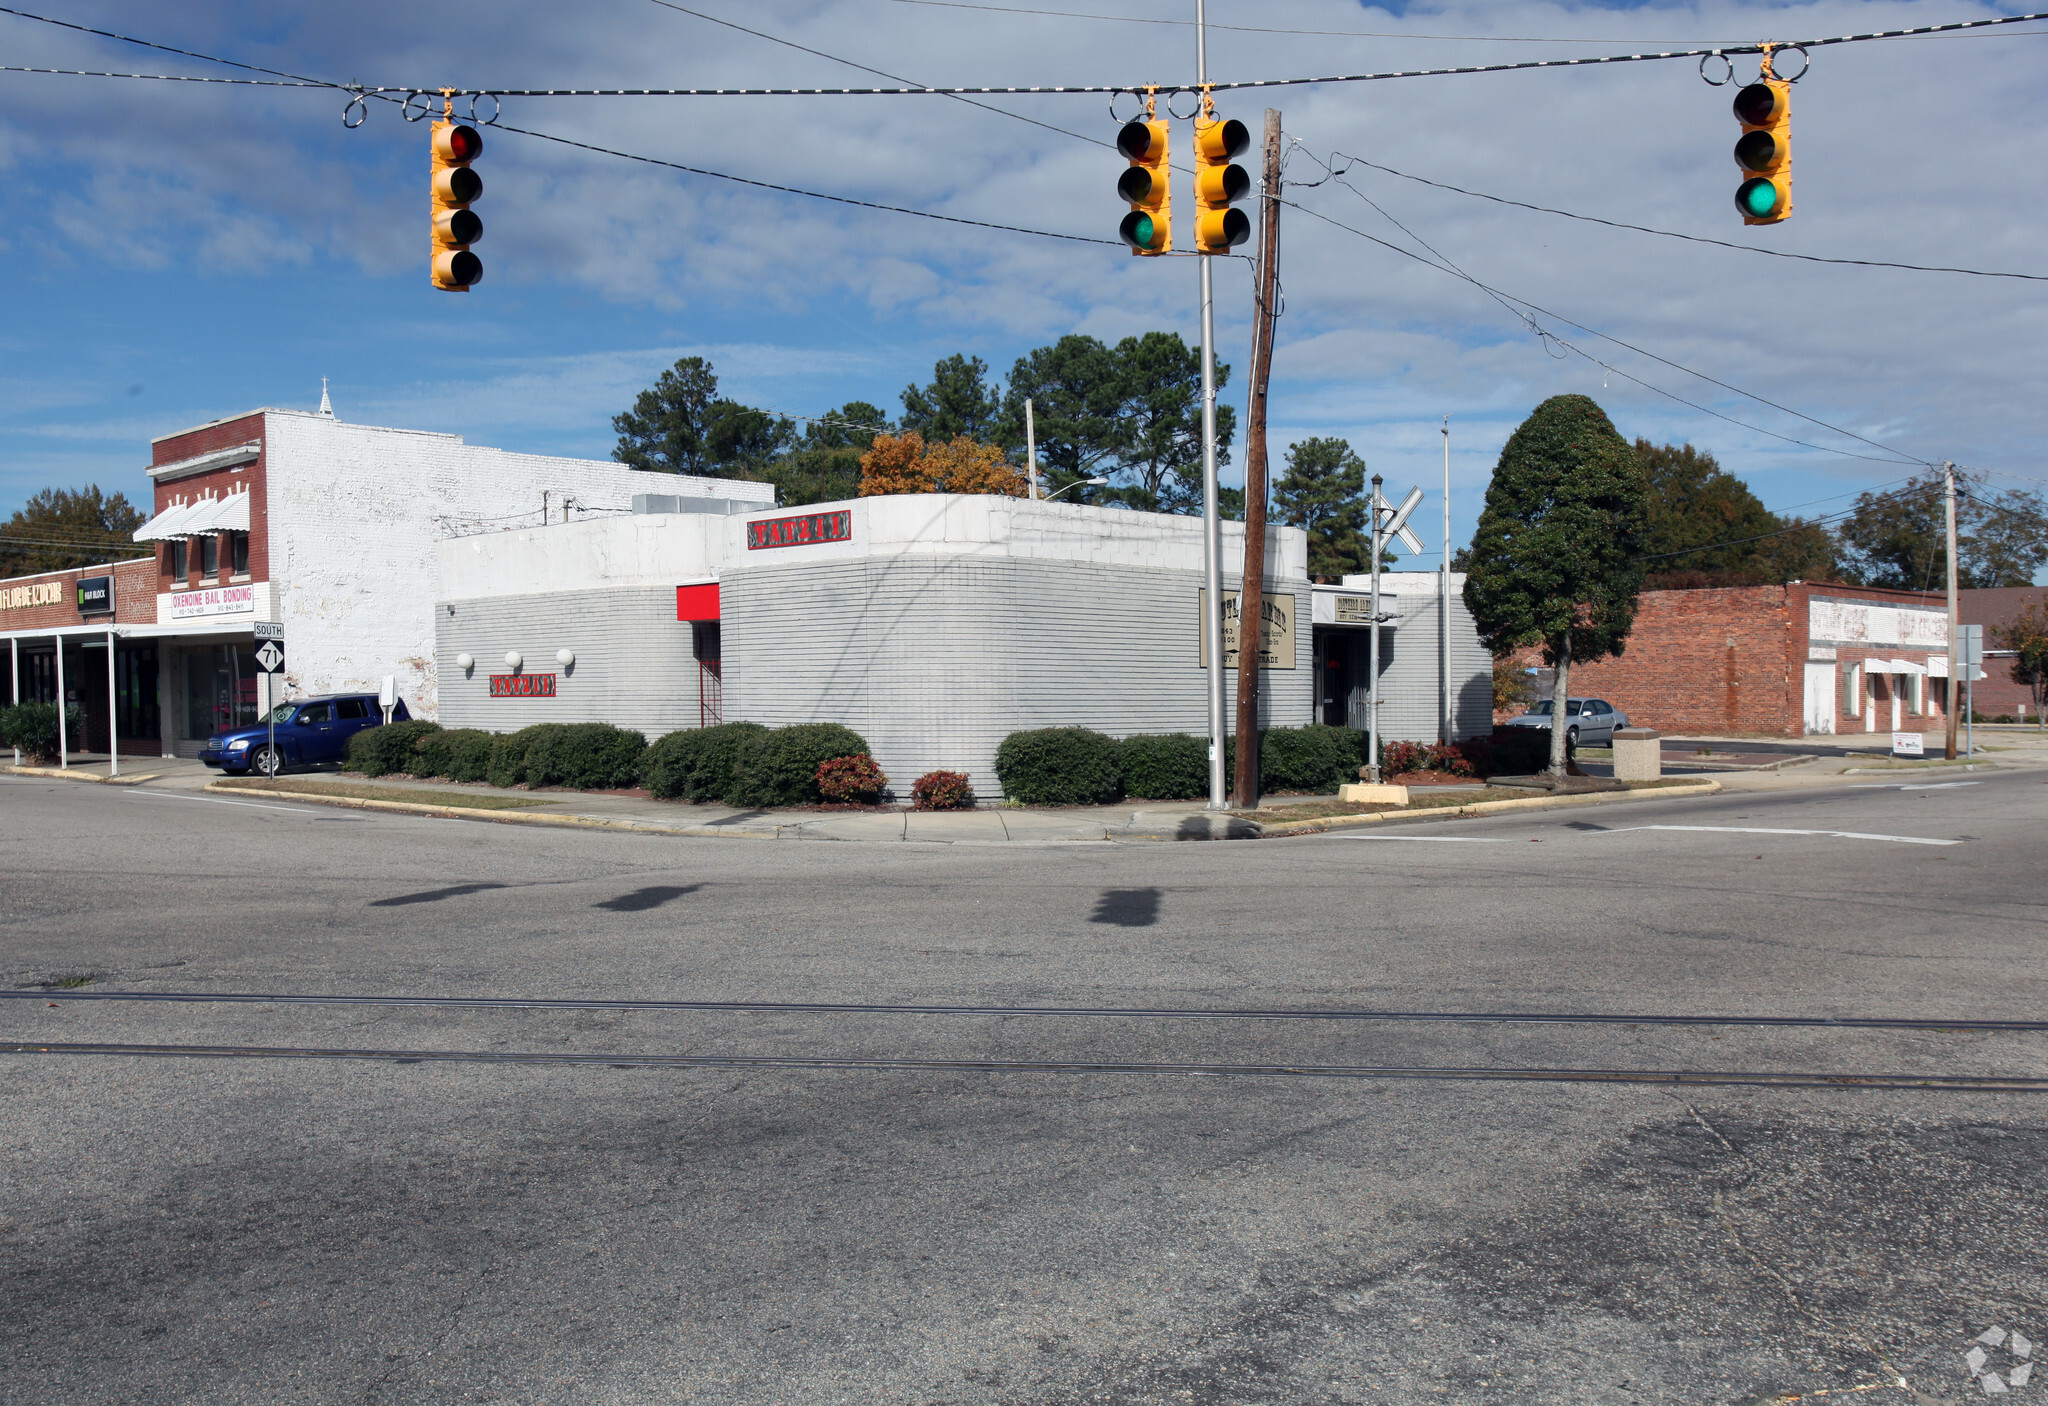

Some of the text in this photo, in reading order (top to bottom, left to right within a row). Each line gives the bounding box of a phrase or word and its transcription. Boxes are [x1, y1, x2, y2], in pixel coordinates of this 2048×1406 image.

[84, 589, 106, 600] H&R BLOCK
[173, 587, 252, 608] OXENDINE BAIL BONDING
[256, 625, 282, 635] SOUTH
[262, 649, 277, 664] 71
